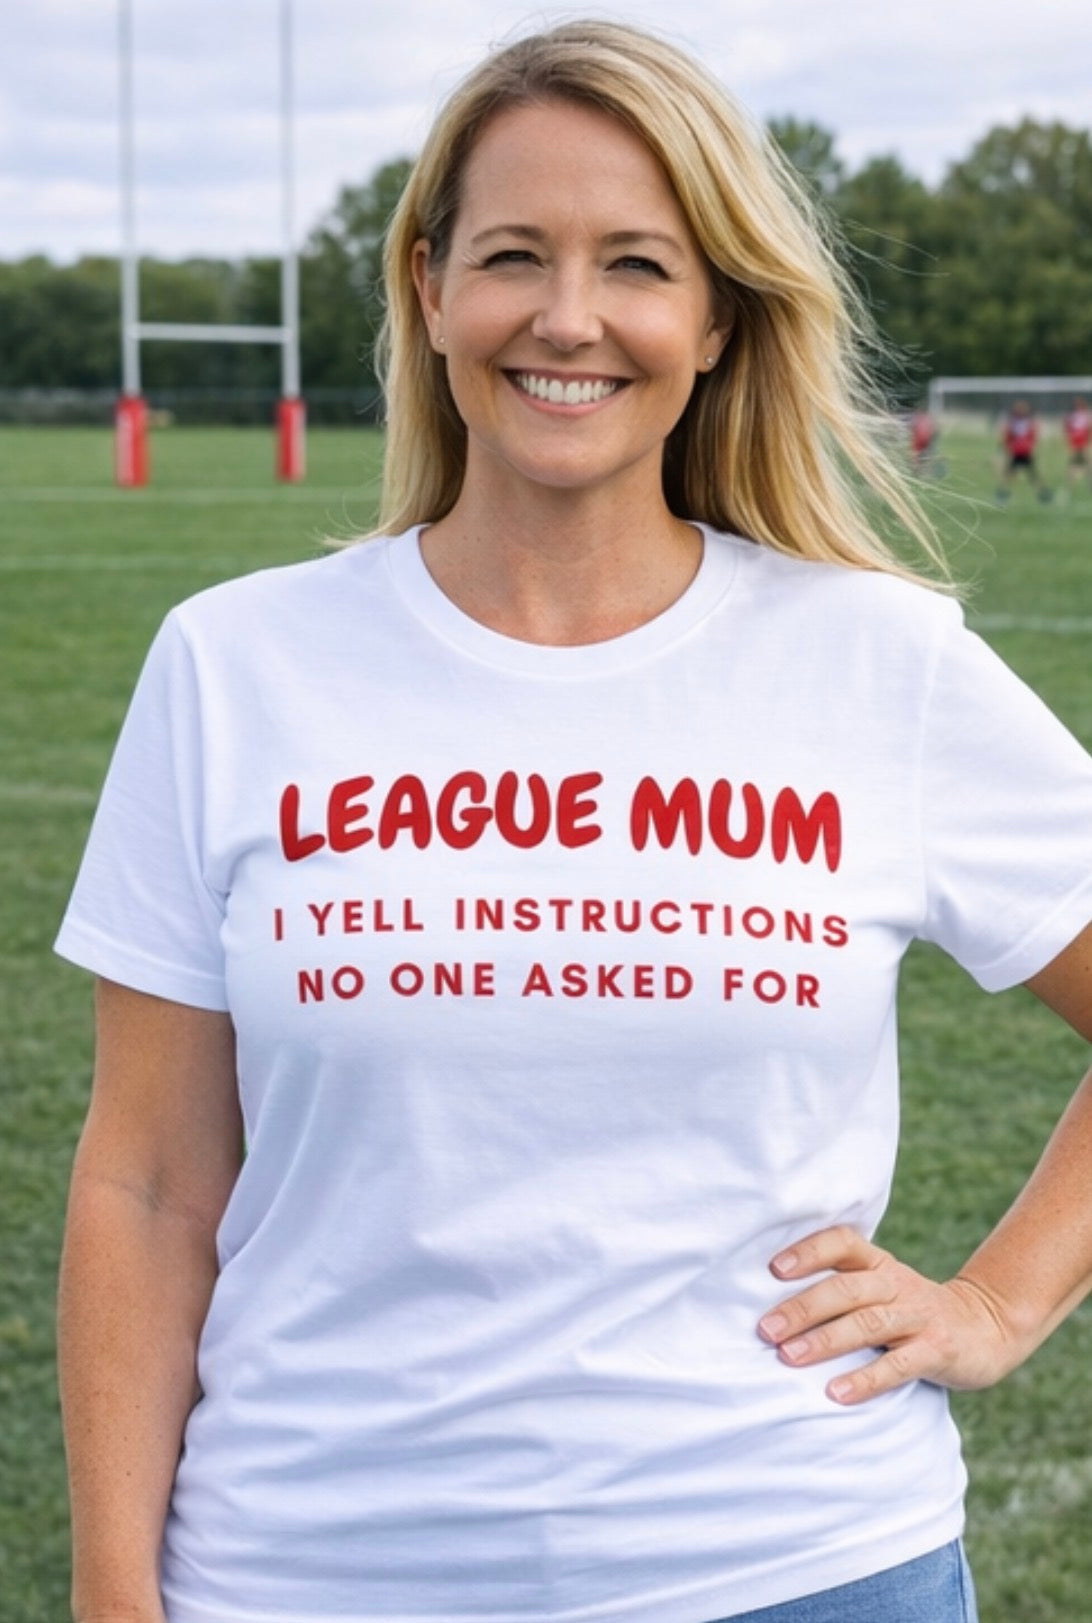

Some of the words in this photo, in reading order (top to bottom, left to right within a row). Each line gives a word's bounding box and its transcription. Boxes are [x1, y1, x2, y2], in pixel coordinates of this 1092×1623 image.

[279, 770, 604, 862] LEAGUE
[629, 775, 843, 873] MUM
[274, 908, 285, 941] I
[308, 899, 425, 936] YELL
[455, 897, 850, 948] INSTRUCTIONS
[298, 965, 365, 1004] NO
[390, 962, 495, 997] ONE
[523, 962, 694, 1000] ASKED
[723, 967, 822, 1009] FOR
